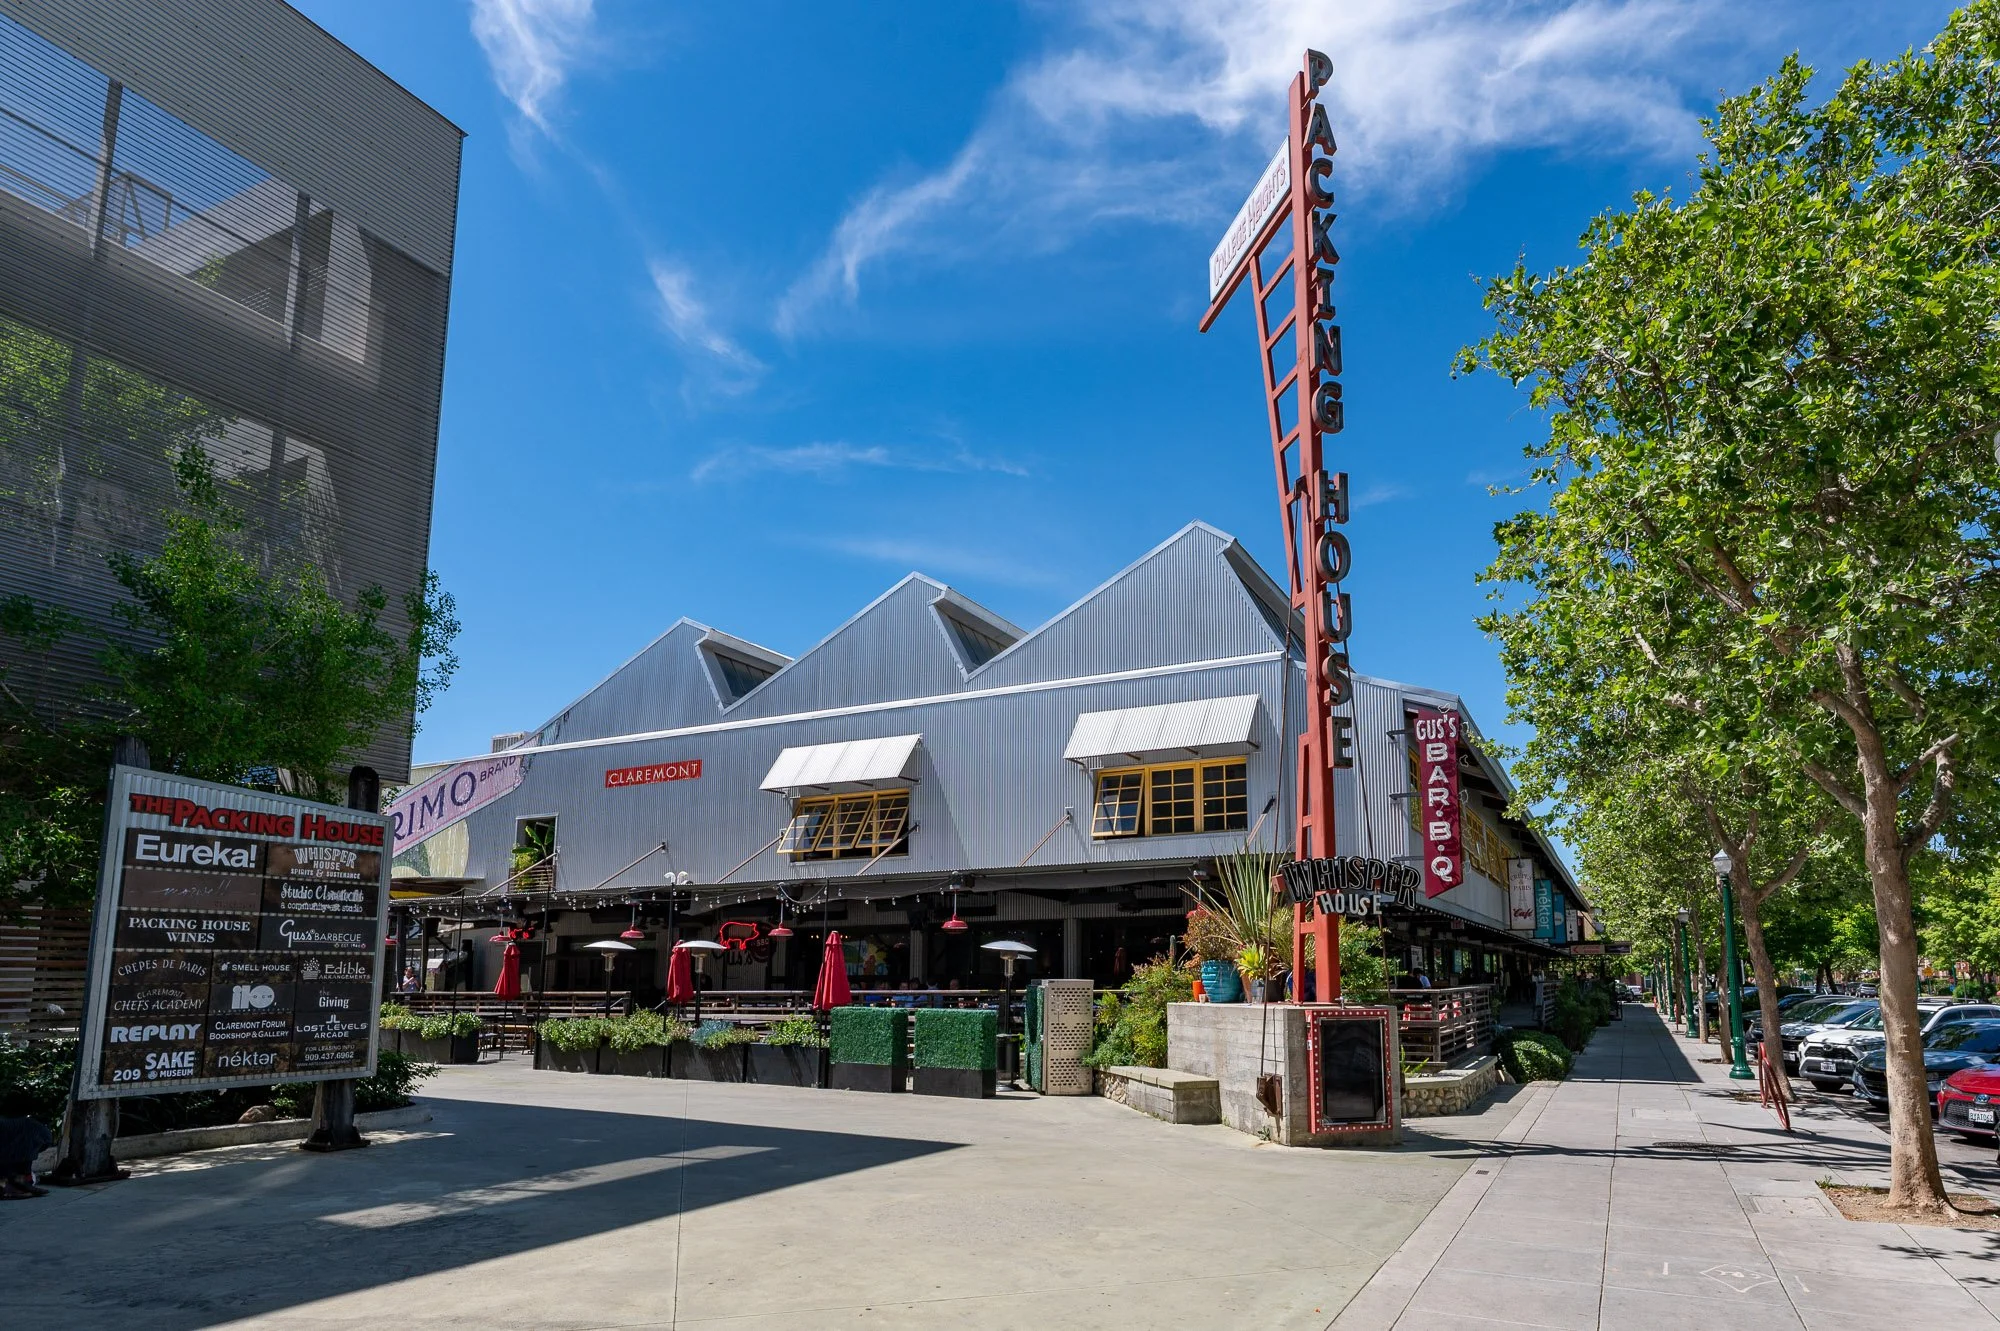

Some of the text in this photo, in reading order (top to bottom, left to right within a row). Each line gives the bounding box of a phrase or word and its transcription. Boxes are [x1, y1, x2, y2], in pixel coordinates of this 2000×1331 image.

[1303, 48, 1345, 434] PACKING
[1313, 470, 1353, 769] HOUSE
[1416, 715, 1457, 741] GUS'S
[480, 756, 516, 782] BRAND
[608, 763, 698, 785] CLAREMONT
[129, 793, 385, 846] THE PACKING HOUSE
[136, 834, 257, 868] Eureka!
[294, 847, 357, 869] WHISPER
[313, 861, 341, 870] HOUSE
[281, 883, 313, 899] Studio
[1281, 856, 1421, 911] WHISPER
[1317, 893, 1382, 916] HOUSE
[128, 917, 250, 931] PACKING HOUSE
[167, 931, 215, 943] WINES
[315, 933, 361, 942] BARBECUE
[162, 959, 176, 969] DE
[179, 961, 207, 976] PARIS
[262, 964, 290, 972] HOUSE
[325, 961, 366, 974] Edible
[136, 988, 185, 999] CLAREMONT
[114, 999, 205, 1011] CHEFS ACADEMY
[319, 996, 350, 1009] Giving
[110, 1023, 202, 1043] REPLAY
[215, 1020, 286, 1030] CLAREMONT FORUM
[327, 1023, 368, 1031] LEVELS
[314, 1031, 349, 1039] ARCADE
[145, 1051, 196, 1070] SAKE
[113, 1069, 193, 1081] 209 MUSEUM
